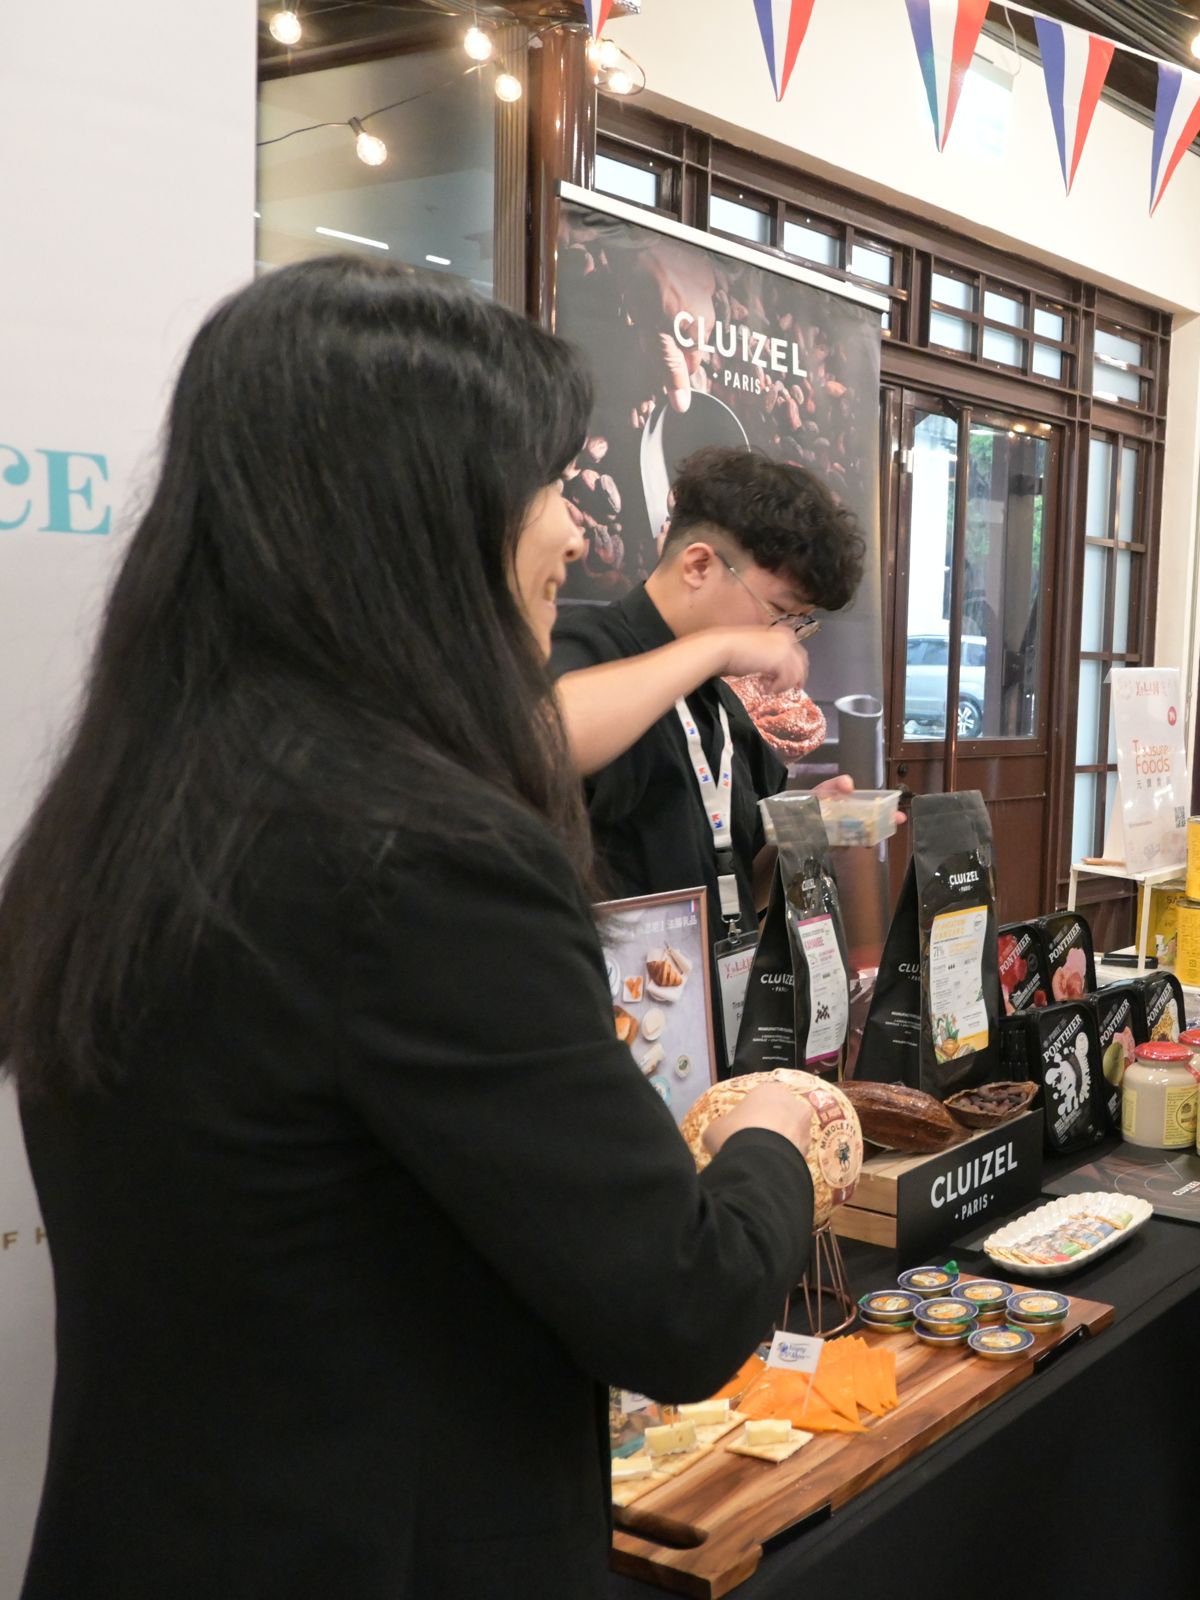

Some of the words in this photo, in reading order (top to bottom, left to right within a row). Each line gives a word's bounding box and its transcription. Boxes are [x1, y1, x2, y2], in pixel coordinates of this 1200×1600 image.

[674, 311, 808, 378] CLUIZEL
[724, 370, 761, 395] PARIS
[1135, 755, 1170, 774] Foods
[949, 871, 979, 886] CLUIZEL
[1000, 933, 1031, 975] PONTHIER
[1048, 922, 1081, 964] PONTHIER
[1099, 998, 1131, 1047] PONTHIER
[1147, 982, 1173, 1027] PONTHIER
[1043, 1013, 1083, 1063] PONTHIER
[930, 1141, 1018, 1209] CLUIZEL
[961, 1193, 988, 1221] PARIS
